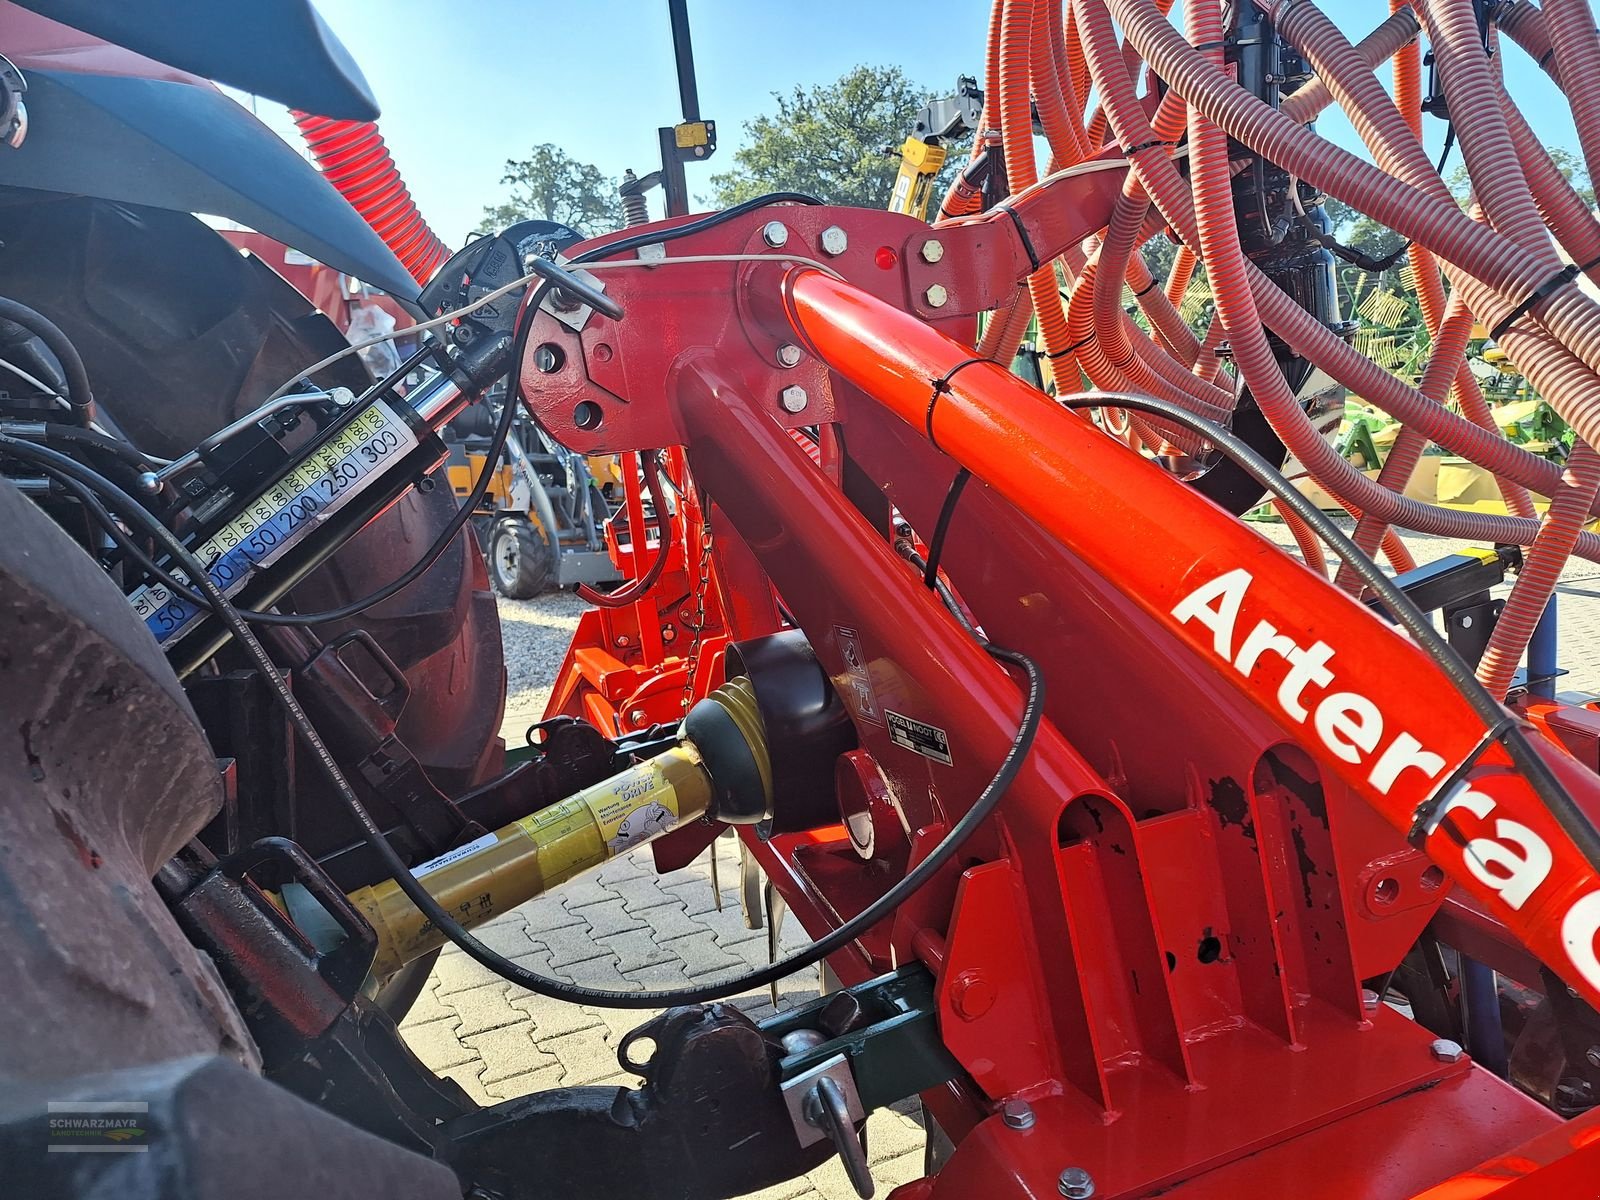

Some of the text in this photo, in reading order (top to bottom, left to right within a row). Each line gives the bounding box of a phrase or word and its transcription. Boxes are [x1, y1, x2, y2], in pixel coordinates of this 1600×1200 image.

[364, 410, 384, 428] 300
[349, 422, 368, 441] 280
[333, 436, 353, 454] 260
[318, 448, 337, 467] 240
[301, 461, 321, 479] 220
[284, 474, 304, 492] 200
[269, 488, 288, 506] 180
[252, 501, 272, 520] 160
[158, 604, 185, 630] 50
[238, 530, 276, 563] 150
[279, 496, 318, 530] 200
[321, 463, 358, 496] 250
[361, 431, 398, 463] 300
[235, 515, 254, 534] 140
[219, 528, 238, 547] 120
[150, 588, 166, 600] 40
[134, 600, 148, 615] 20
[912, 724, 932, 737] NOOT
[1171, 568, 1553, 911] Arterra
[622, 781, 654, 802] DRIVE
[598, 802, 619, 814] Wartung
[600, 803, 632, 819] Maintenance
